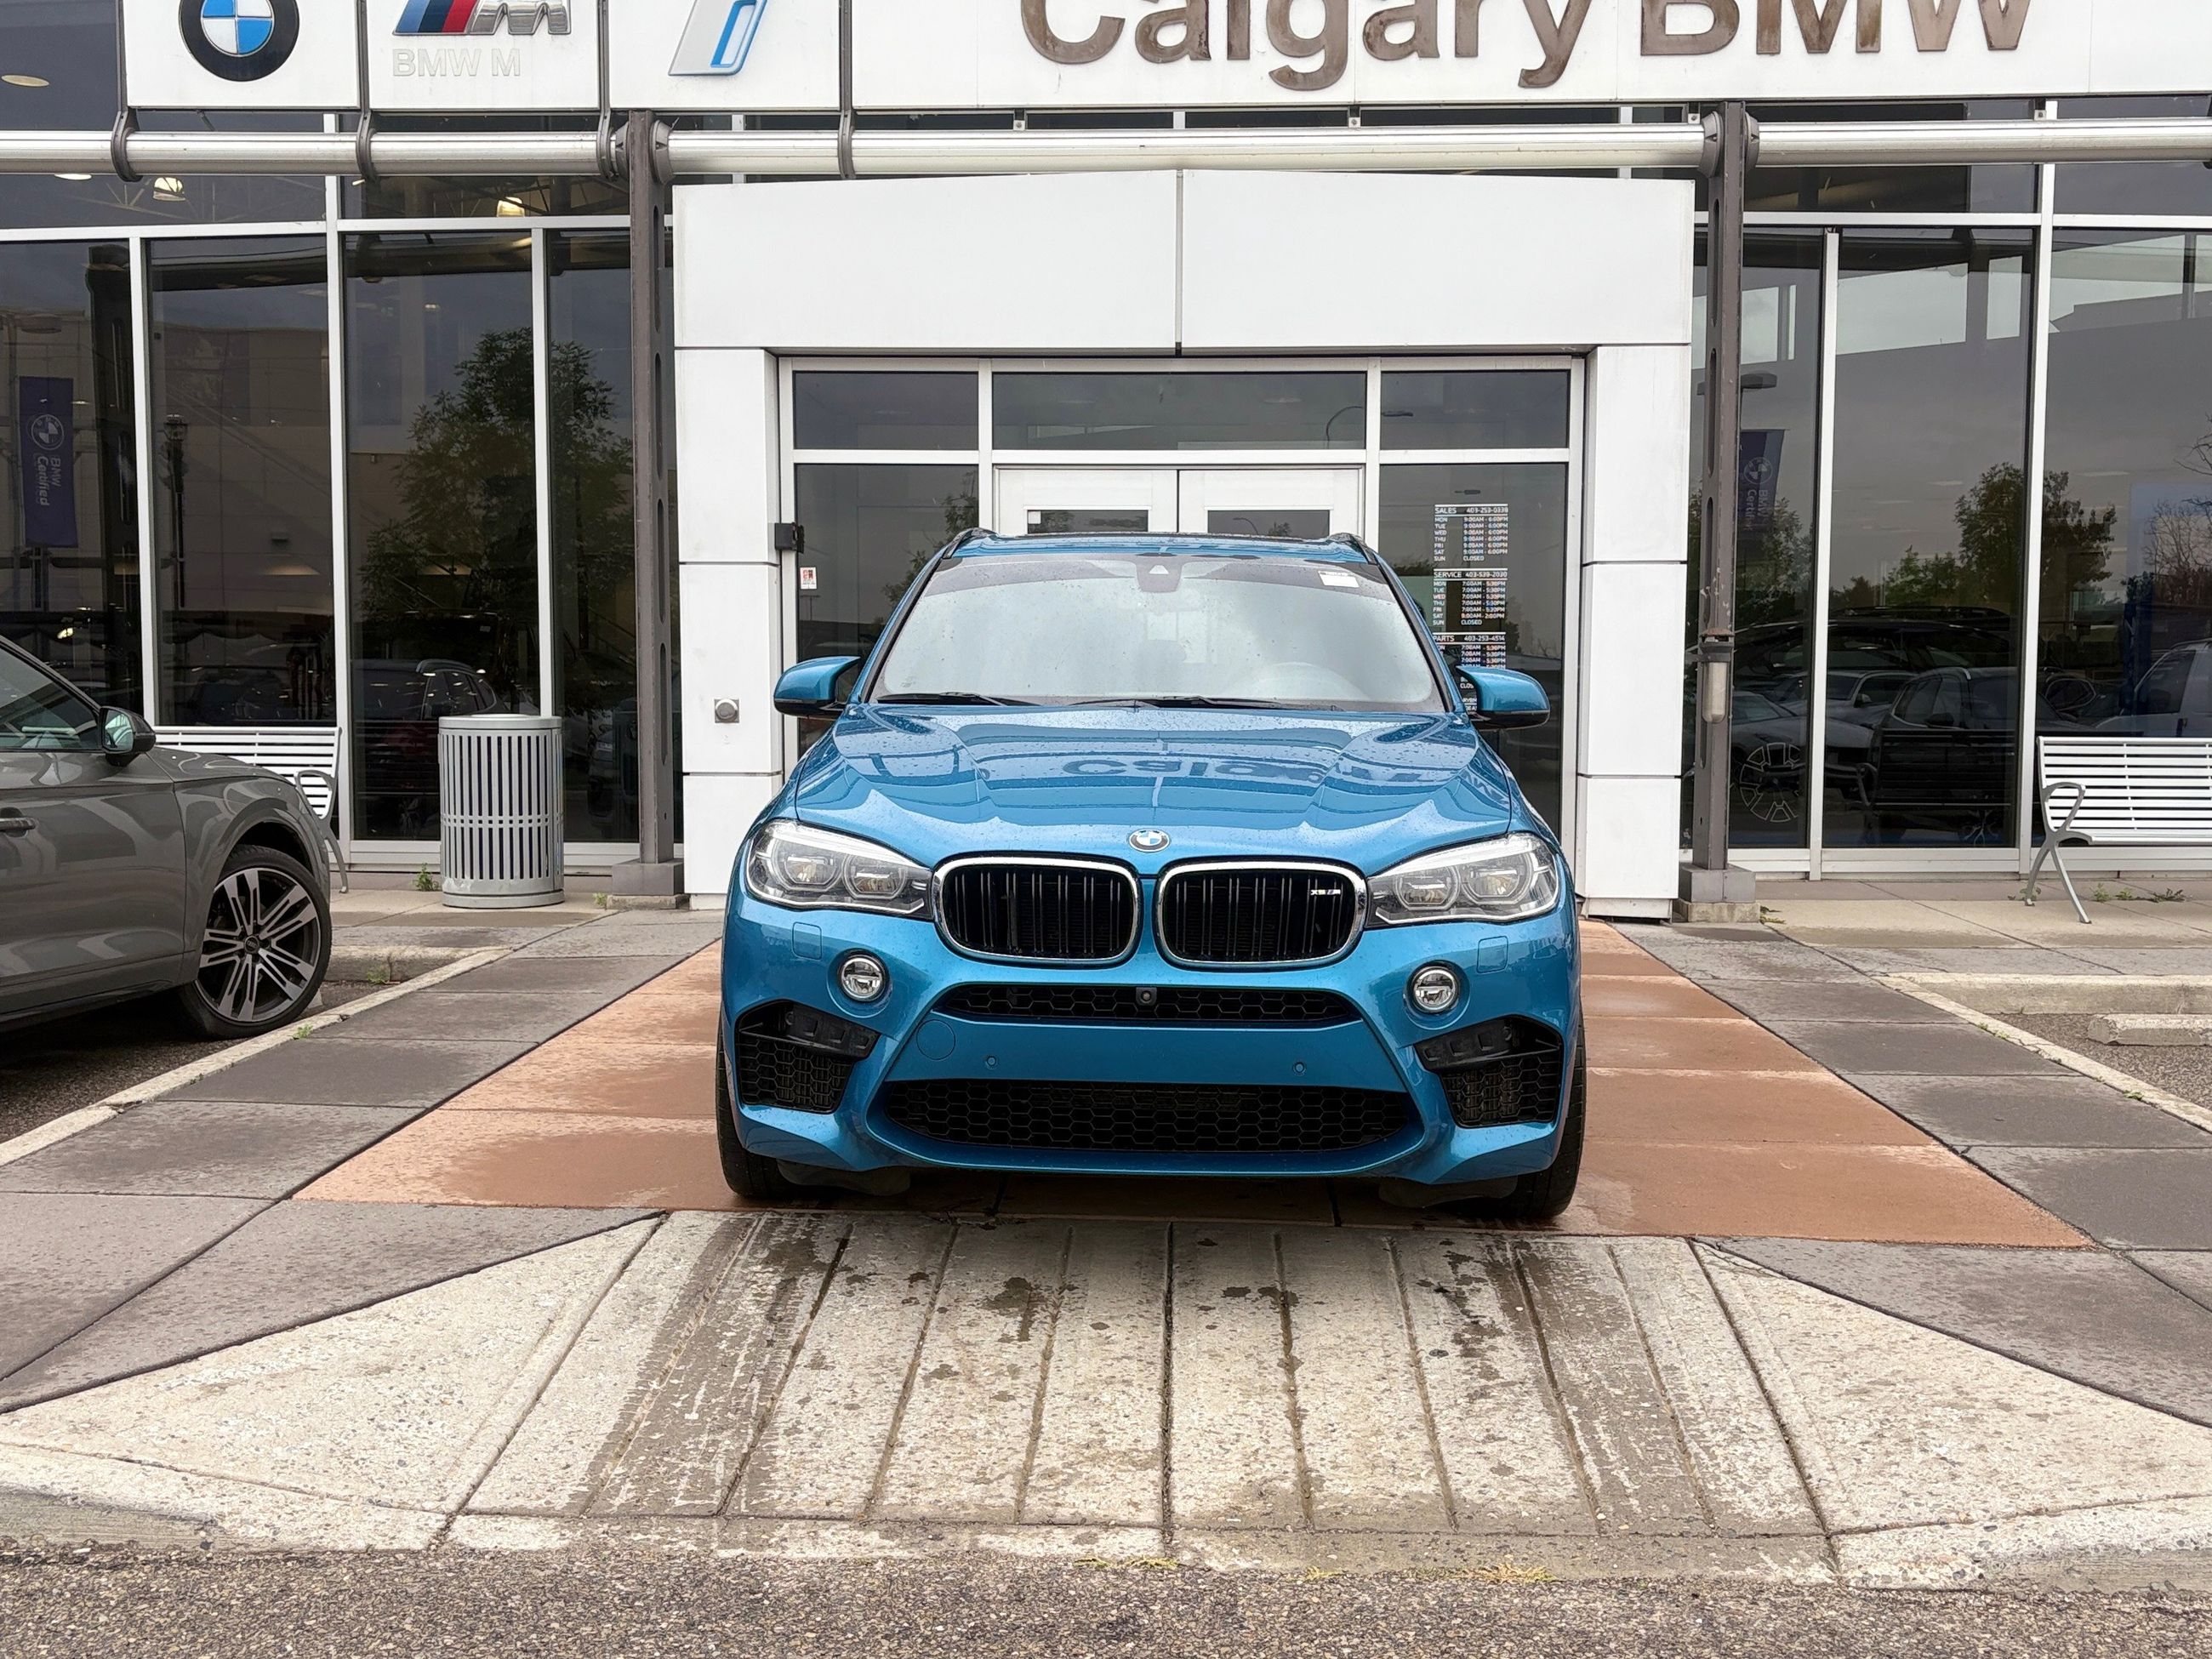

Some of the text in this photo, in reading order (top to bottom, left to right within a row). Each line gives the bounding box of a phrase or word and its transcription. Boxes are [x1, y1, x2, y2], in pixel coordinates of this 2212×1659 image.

[392, 48, 522, 77] BMW M
[37, 455, 50, 506] Certified
[50, 457, 61, 487] BMW
